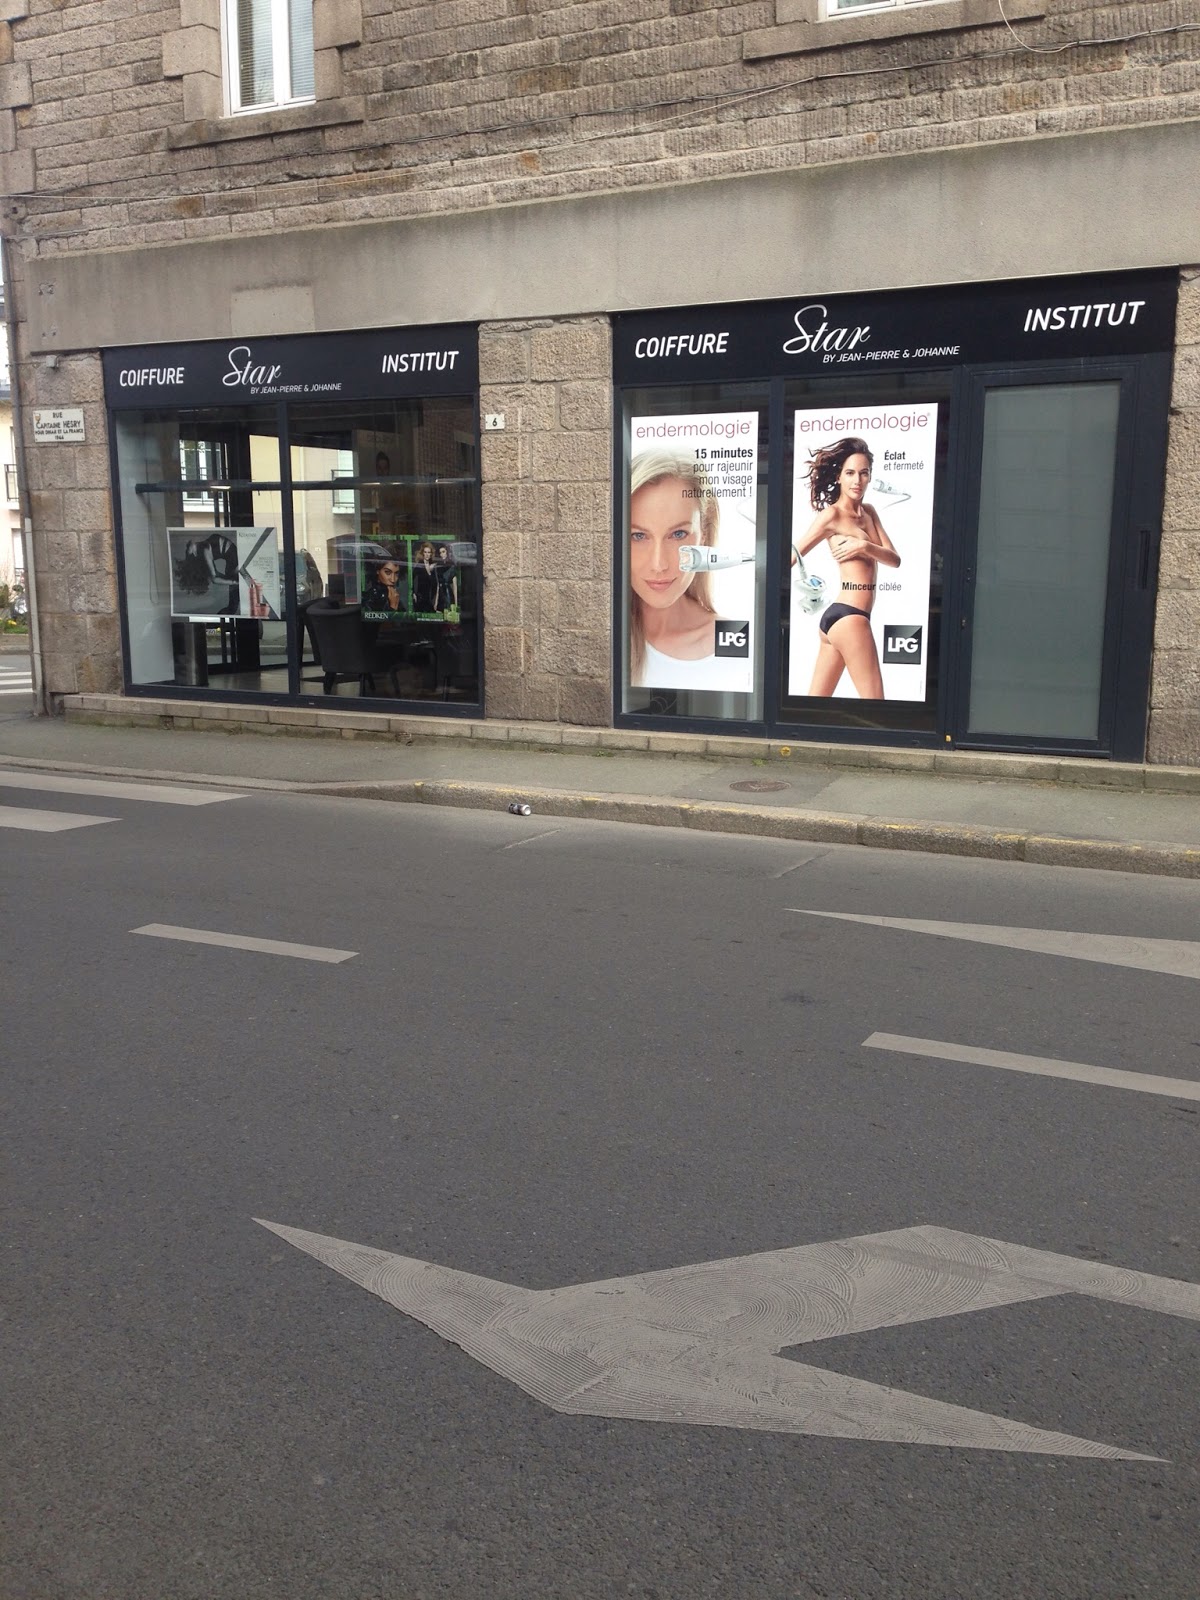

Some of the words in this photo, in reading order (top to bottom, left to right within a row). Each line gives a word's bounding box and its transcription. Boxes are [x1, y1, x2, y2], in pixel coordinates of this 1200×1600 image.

[1023, 300, 1146, 332] INSTITUT
[782, 304, 871, 354] Star
[634, 332, 730, 358] COIFFURE
[381, 350, 460, 374] INSTITUT
[822, 354, 835, 363] BY
[836, 349, 900, 363] JEAN-PIERRE
[901, 349, 910, 359] &
[911, 345, 961, 358] JOHANNE
[222, 345, 282, 386] Star
[119, 366, 185, 387] COIFFURE
[250, 386, 260, 394] BY
[260, 385, 302, 394] JEAN-PIERRE
[304, 384, 309, 392] &
[310, 383, 342, 392] JOHANNE
[492, 417, 498, 427] 6
[636, 420, 750, 439] endermologie
[800, 411, 928, 432] endermologie
[694, 448, 707, 460] 15
[710, 447, 753, 460] minutes
[884, 450, 906, 461] Éclat
[693, 464, 715, 474] pour
[717, 460, 753, 475] rajeunir
[883, 462, 892, 471] et
[893, 460, 925, 471] fermeté
[699, 475, 720, 485] mon
[722, 473, 753, 487] visage
[682, 486, 746, 498] naturellement
[842, 582, 876, 591] Minceur
[878, 582, 902, 592] ciblée
[364, 612, 389, 620] REDKEN
[718, 631, 747, 648] LPG
[887, 636, 919, 654] LPG
